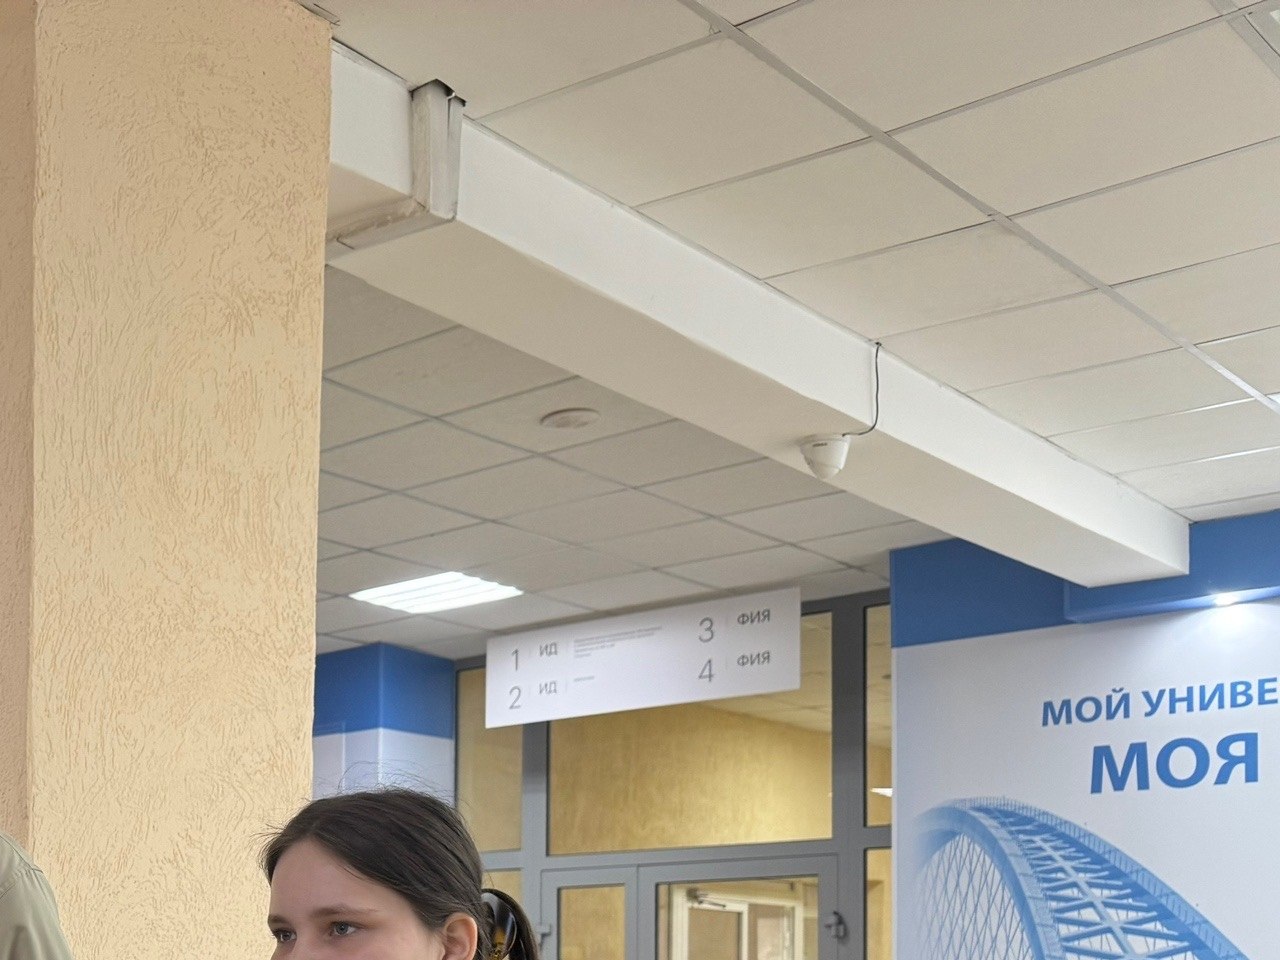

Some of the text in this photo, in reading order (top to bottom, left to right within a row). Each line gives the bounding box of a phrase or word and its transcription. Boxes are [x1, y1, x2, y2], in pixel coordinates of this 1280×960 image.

[698, 608, 771, 643] 3 ФИЯ
[511, 648, 521, 671] 1
[539, 641, 559, 658] ИД
[697, 650, 771, 683] 4 ФИЯ
[508, 680, 558, 710] 2 ИД
[1042, 677, 1278, 727] МОЙ УНИВЕ
[1091, 732, 1259, 794] МОЯ
